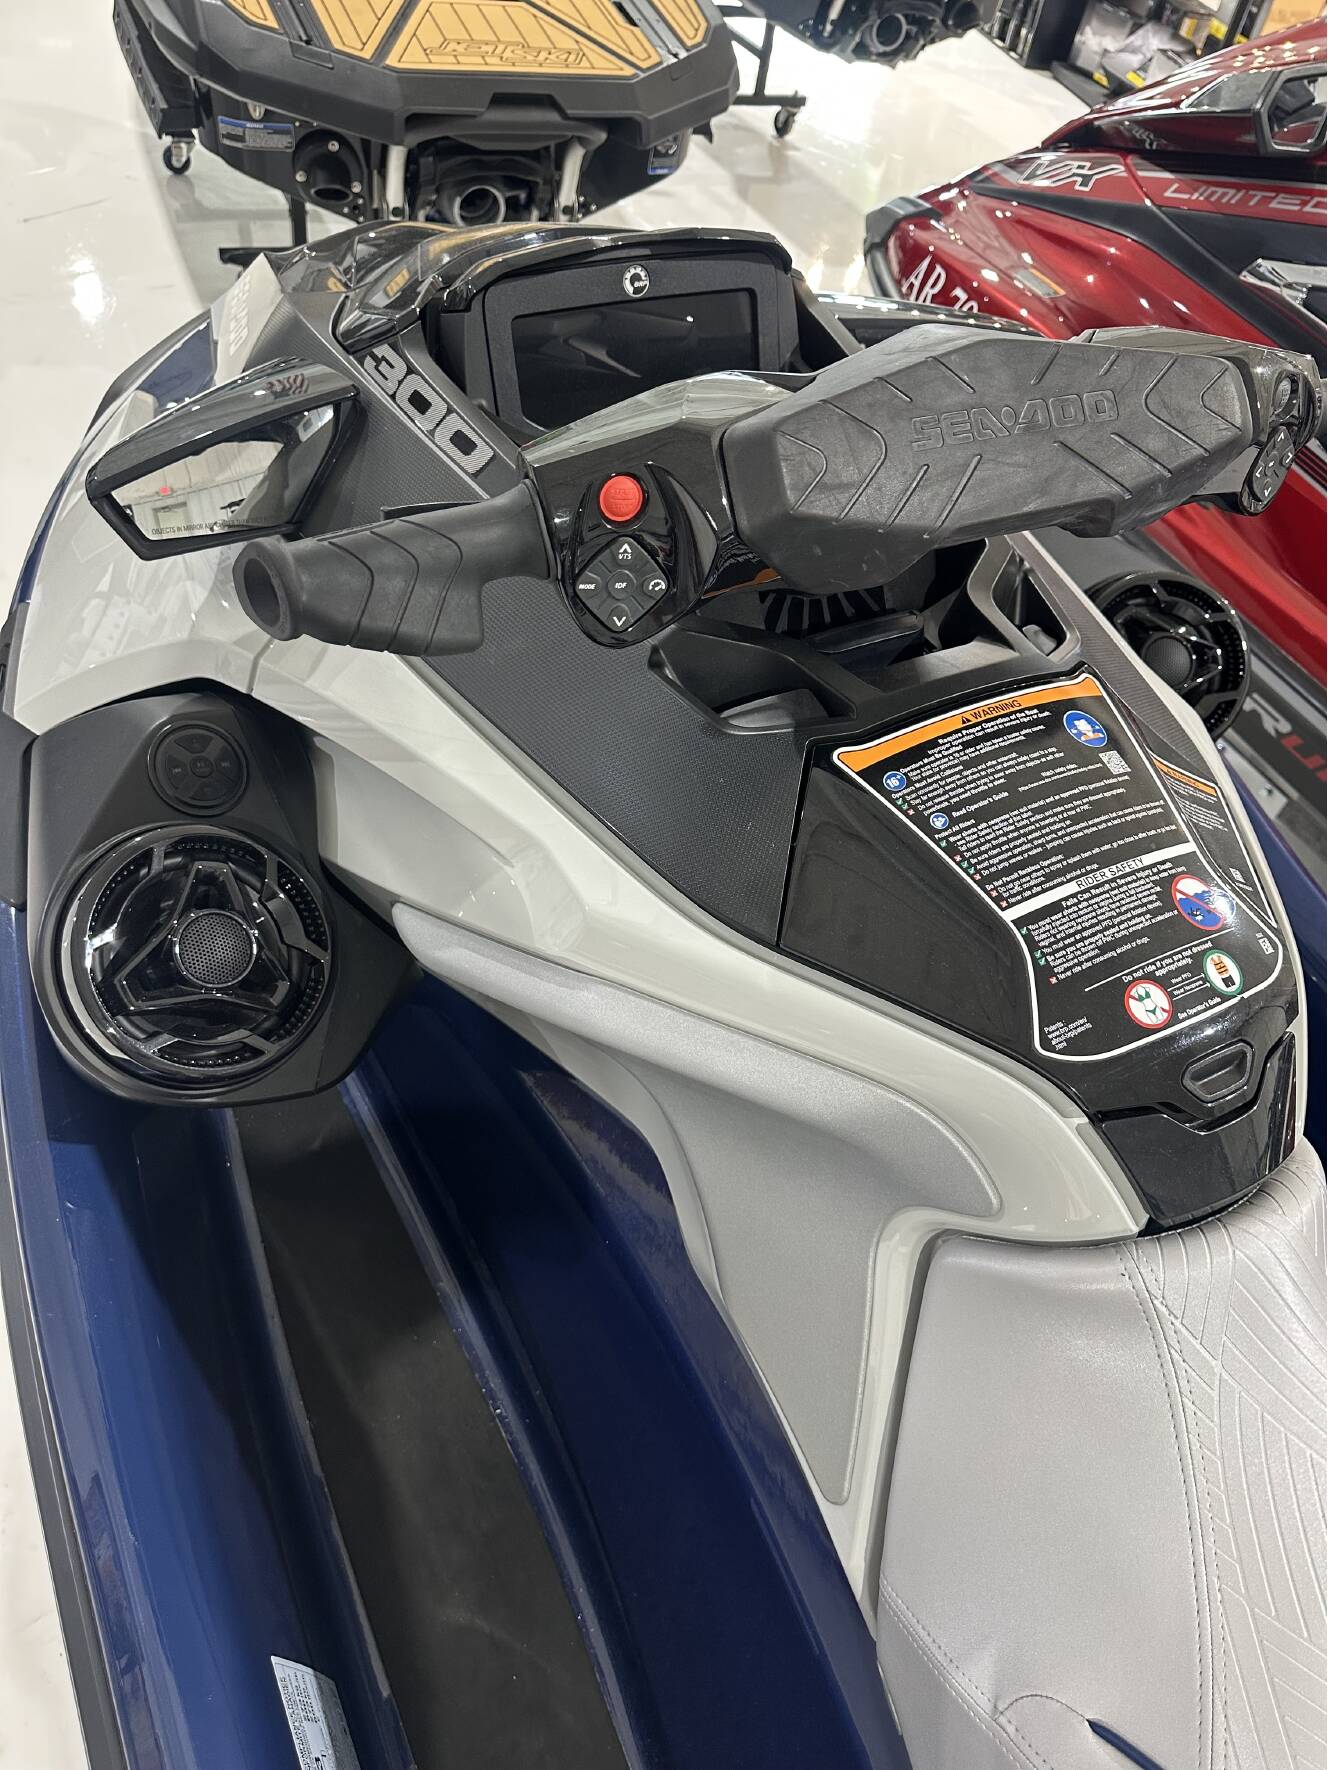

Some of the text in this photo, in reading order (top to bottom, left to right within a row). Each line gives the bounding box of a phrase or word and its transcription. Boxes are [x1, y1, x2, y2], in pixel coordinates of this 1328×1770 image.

[1017, 160, 1125, 192] VX
[901, 254, 946, 304] AR
[364, 343, 495, 474] 300
[970, 699, 1022, 720] WARNING
[938, 732, 963, 746] Require
[961, 725, 983, 737] Proper
[981, 716, 1010, 730] Operation
[952, 791, 1009, 818] Read Operator's Guide
[1061, 897, 1078, 908] Falls
[1078, 891, 1092, 901] Can
[1090, 884, 1111, 895] Result
[1116, 874, 1137, 885] Severe
[1136, 869, 1153, 879] Injury
[1157, 862, 1173, 871] Death
[1076, 858, 1144, 888] RIDER SAFETY
[1008, 894, 1022, 903] Never
[1042, 875, 1066, 890] consuming
[1042, 946, 1052, 954] You
[1101, 920, 1113, 928] PFD
[1057, 970, 1072, 980] Never
[1081, 961, 1092, 969] after
[1092, 950, 1117, 965] consuming
[1122, 974, 1133, 982] Do
[1132, 969, 1144, 978] not
[1143, 964, 1156, 973] ride
[1161, 958, 1174, 967] you
[1182, 949, 1193, 957] not
[1191, 941, 1213, 953] dressed
[1178, 1011, 1188, 1019] See
[1208, 997, 1222, 1006] Guide
[1044, 1021, 1063, 1033] Patents
